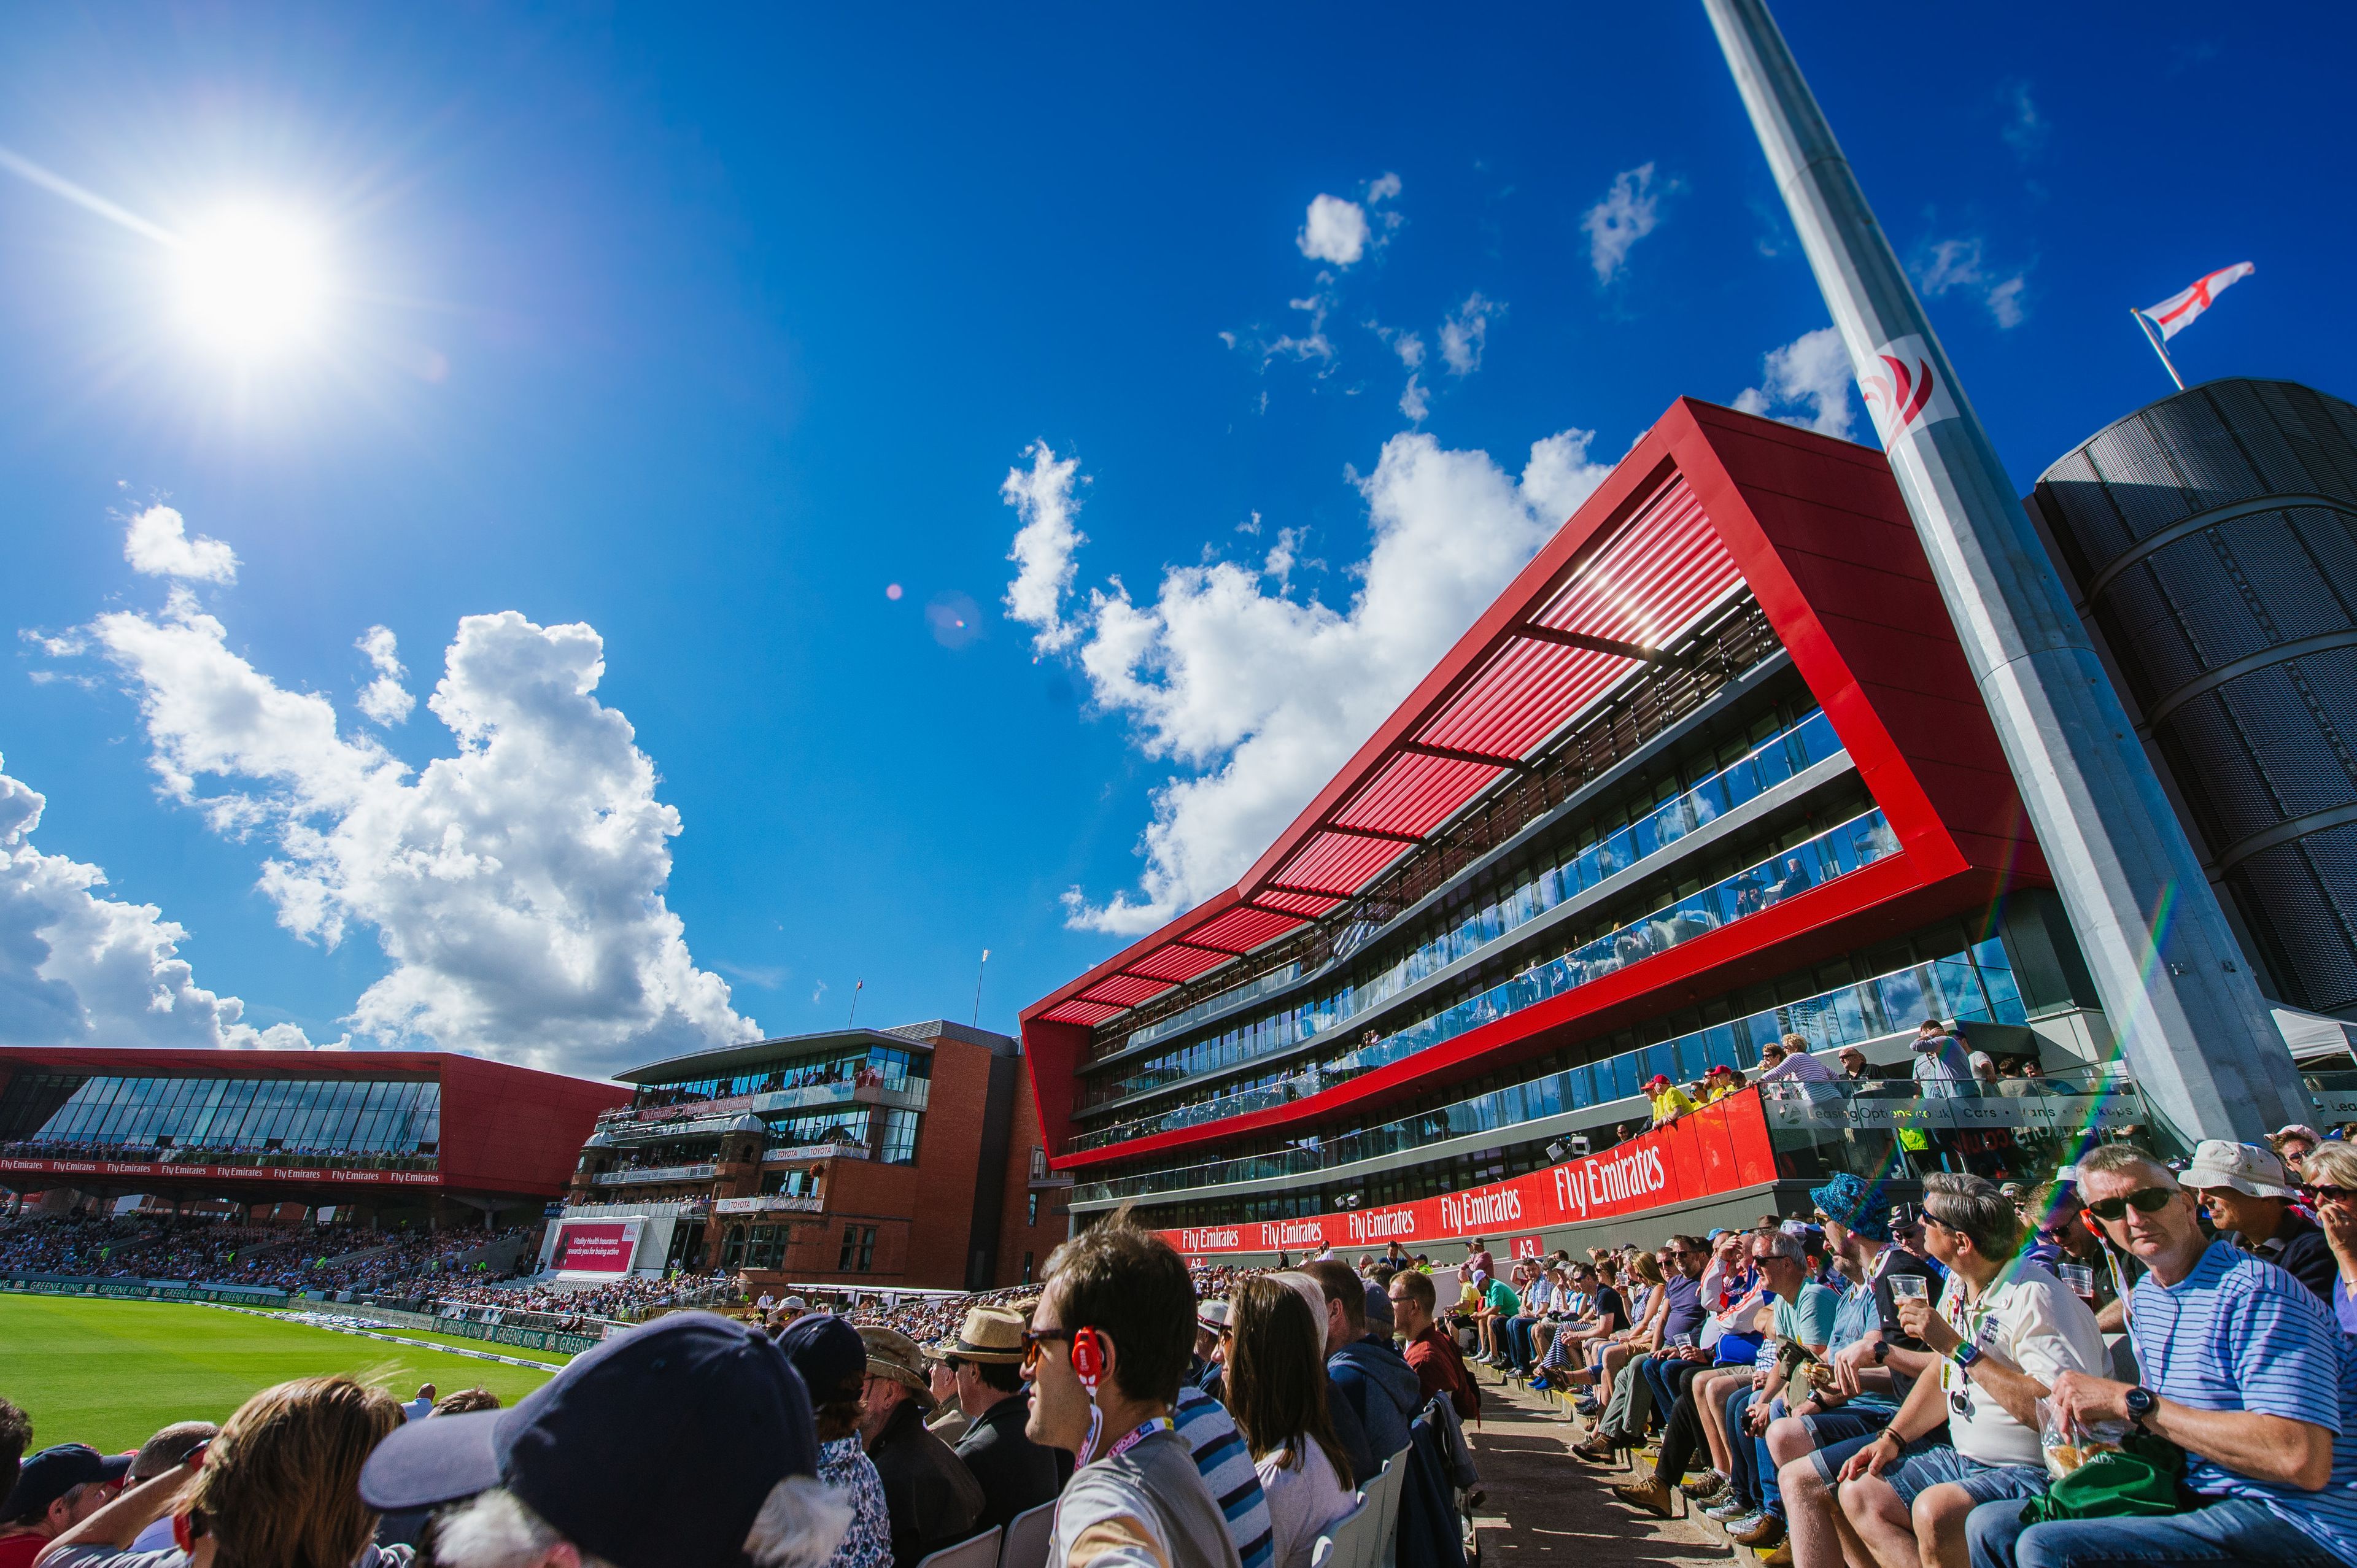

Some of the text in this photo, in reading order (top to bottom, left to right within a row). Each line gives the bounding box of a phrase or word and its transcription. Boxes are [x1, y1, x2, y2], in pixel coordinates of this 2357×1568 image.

[716, 1097, 751, 1110] Fly Emirates
[641, 1111, 650, 1120] Fly
[650, 1108, 671, 1119] Emirates
[1807, 1107, 1951, 1122] LeasingOptionscouk
[1964, 1108, 1997, 1118] Cars
[2023, 1107, 2056, 1118] ans
[778, 1149, 797, 1158] TOYOTA
[810, 1146, 831, 1155] TOYOTA
[1, 1160, 43, 1170] Fly Emirates
[53, 1162, 96, 1172] Fly Emirates
[107, 1164, 150, 1173] Fly Emirates
[161, 1165, 206, 1176] Fly Emirates
[217, 1167, 263, 1177] Fly Emirates
[274, 1168, 320, 1180] Fly Emirates
[332, 1170, 379, 1181] Fly Emirates
[391, 1172, 439, 1183] Fly Emirates
[1554, 1145, 1665, 1217] Fly Emirates
[730, 1200, 750, 1209] TOYOTA
[1441, 1186, 1521, 1234] Fly Emirates
[1349, 1208, 1415, 1244] Fly Emirates
[1182, 1227, 1239, 1252] Fly Emirates
[1261, 1220, 1322, 1249] Fly Emirates
[574, 1237, 587, 1246] Vitality
[595, 1246, 606, 1257] being
[1520, 1240, 1535, 1259] A3
[1191, 1258, 1201, 1269] A2
[31, 1281, 82, 1292] GREENE KING
[99, 1285, 149, 1296] GREENE KING
[164, 1289, 207, 1300] GREENE KING
[220, 1292, 245, 1303] GREENE
[246, 1294, 260, 1303] KING
[444, 1319, 484, 1338] GREENE KING
[496, 1328, 522, 1346] GREENE
[522, 1332, 543, 1347] KING
[560, 1336, 591, 1353] GREENE
